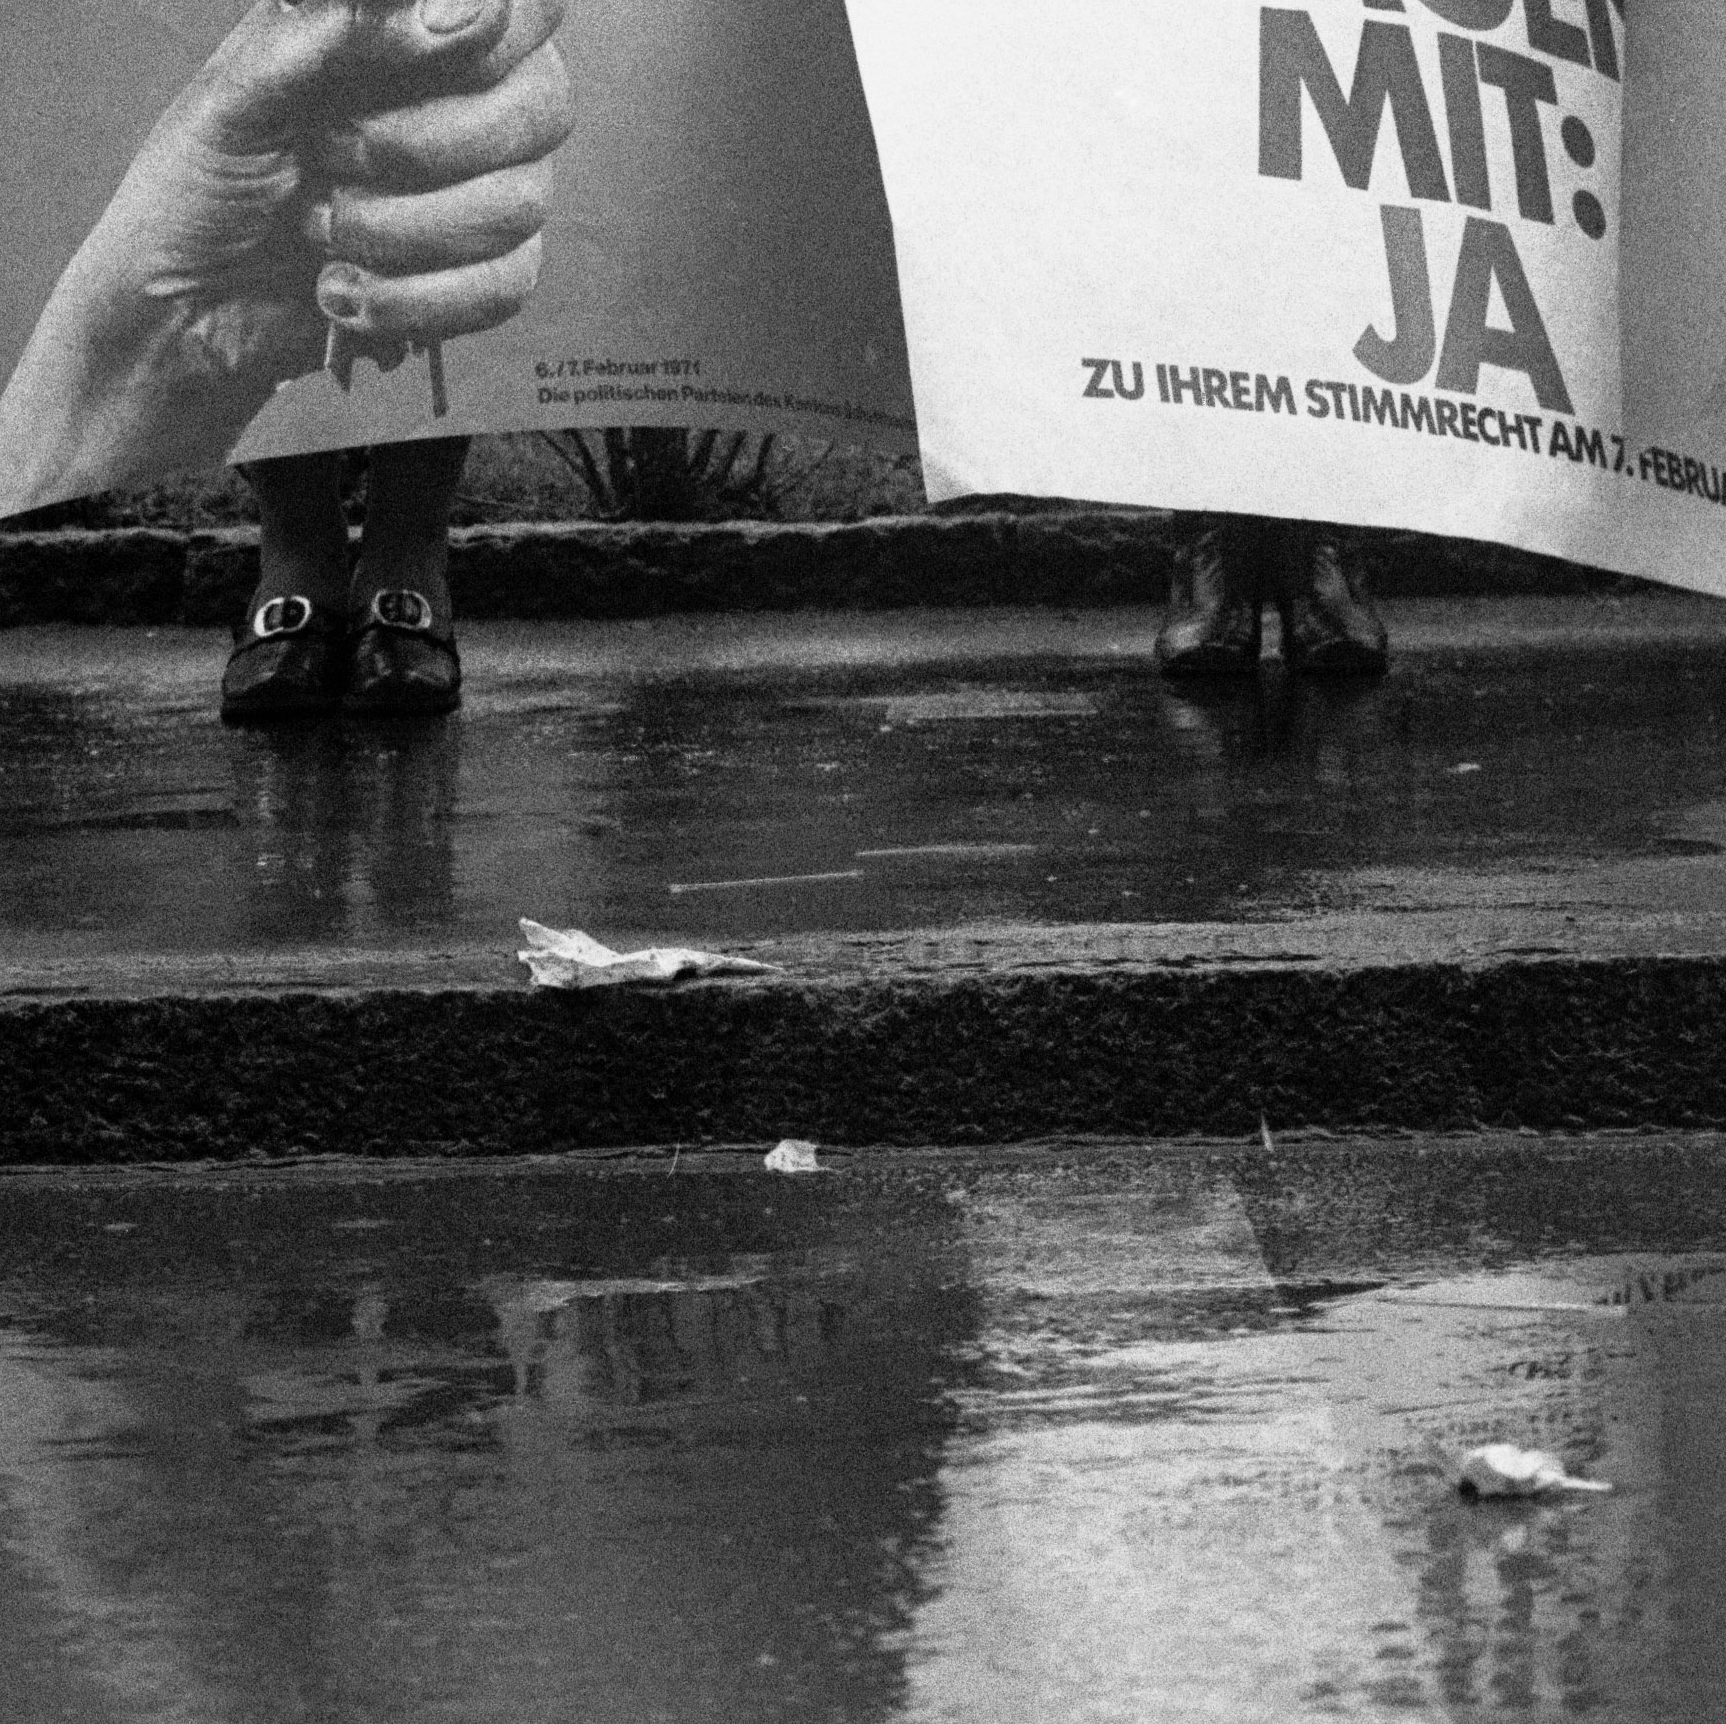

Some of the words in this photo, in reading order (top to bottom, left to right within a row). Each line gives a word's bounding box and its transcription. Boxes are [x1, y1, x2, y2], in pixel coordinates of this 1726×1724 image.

[1257, 5, 1607, 240] MIT:
[583, 357, 658, 377] Februar
[1351, 202, 1575, 416] JA
[538, 386, 570, 404] Die
[574, 383, 678, 405] politischen
[1081, 357, 1146, 400] ZU
[1157, 362, 1299, 416] IHREM
[1305, 377, 1543, 455] STIMMRECHT
[1548, 419, 1608, 470] AM
[1609, 433, 1635, 478] 7.
